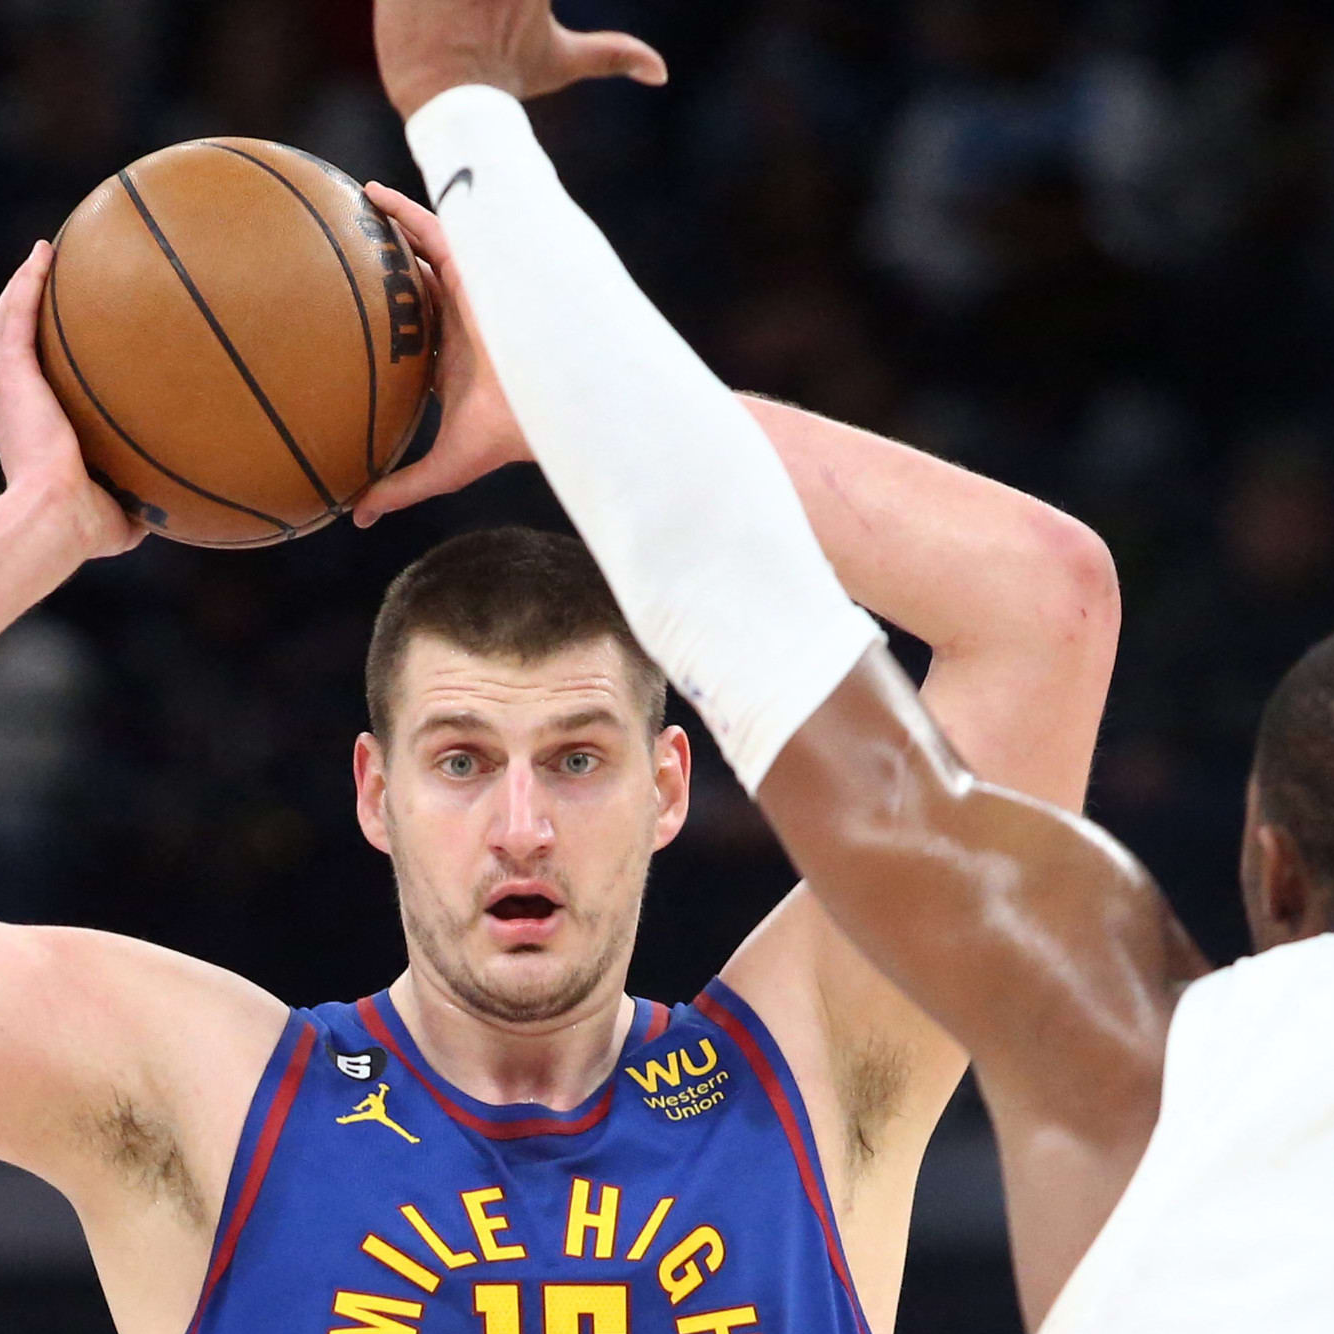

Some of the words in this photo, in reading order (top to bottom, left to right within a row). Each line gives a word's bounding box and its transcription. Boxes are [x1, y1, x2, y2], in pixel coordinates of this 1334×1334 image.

[336, 1053, 372, 1080] 6
[624, 1037, 718, 1094] WU
[643, 1070, 730, 1110] Western
[665, 1091, 725, 1121] Union
